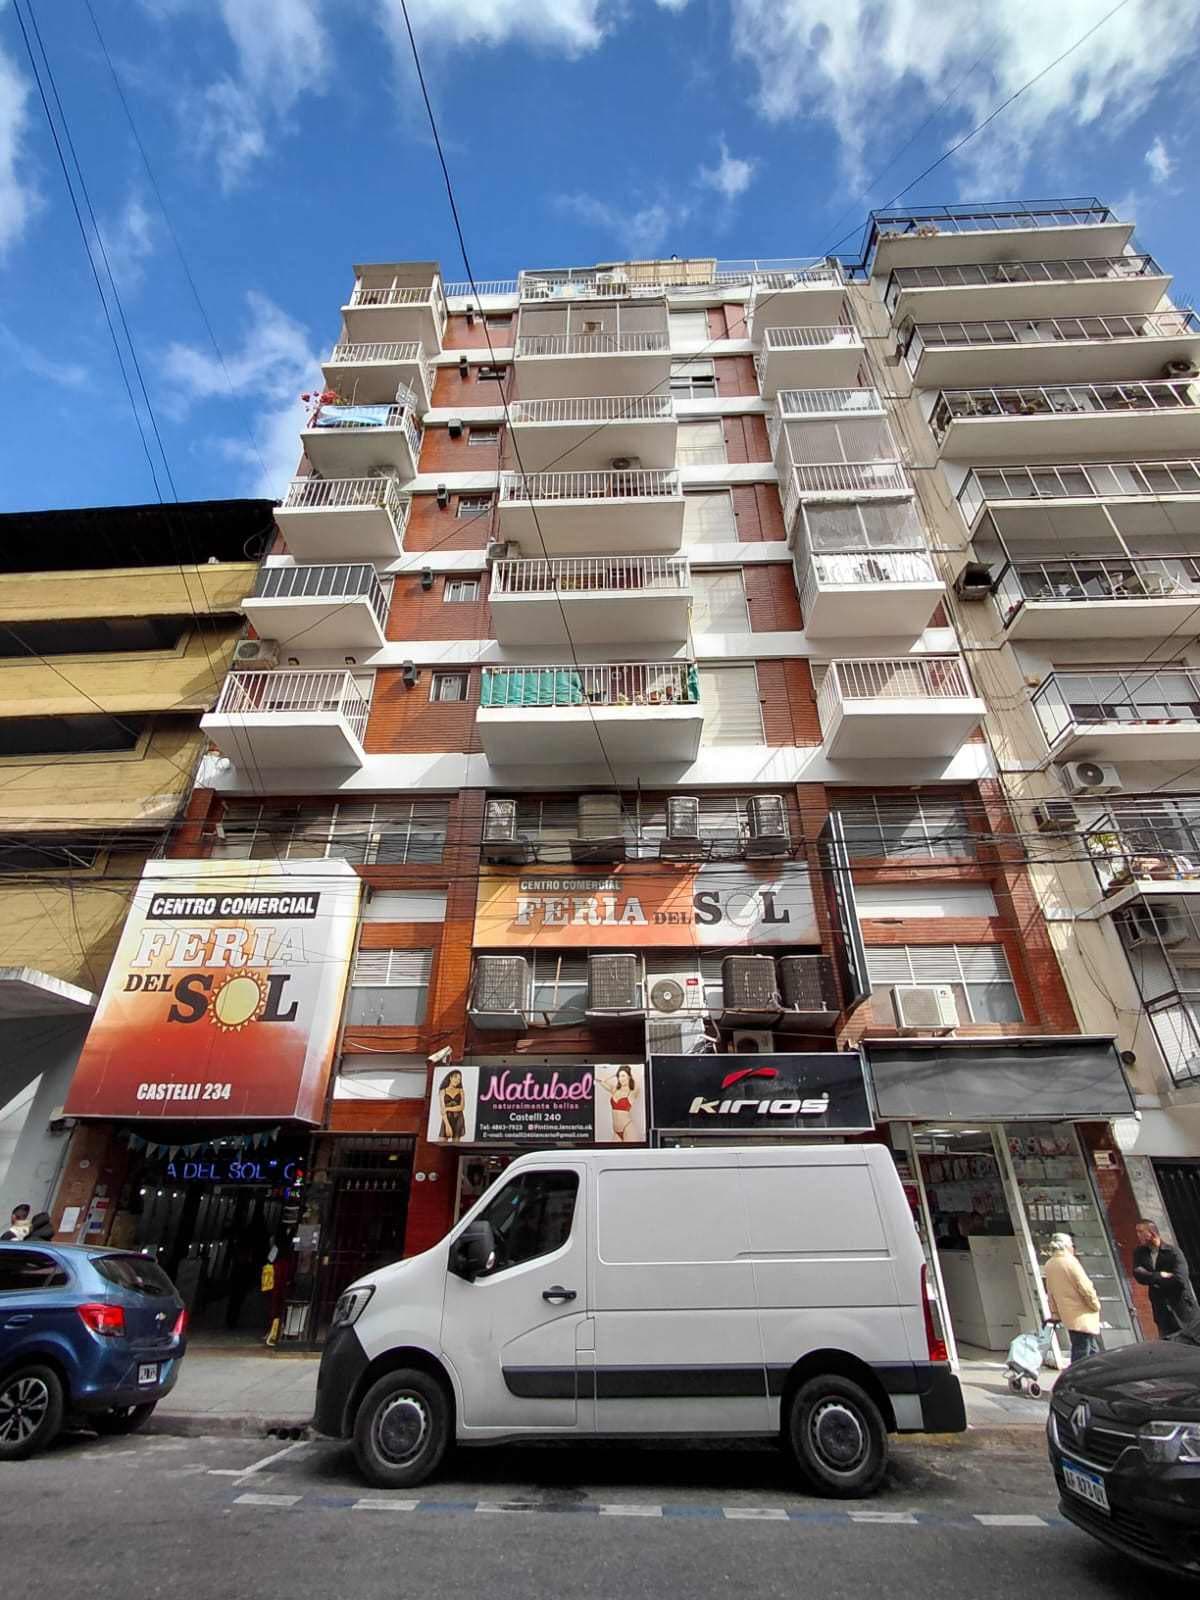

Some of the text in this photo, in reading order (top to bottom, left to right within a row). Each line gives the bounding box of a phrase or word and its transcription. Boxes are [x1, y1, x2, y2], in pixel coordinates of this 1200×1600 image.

[519, 880, 621, 892] CENTRO COMERCIAL
[152, 896, 316, 916] CENTRO COMERCIAL
[514, 891, 790, 927] FERIA DEL SOL
[130, 927, 308, 968] FERIA
[123, 970, 299, 1028] DEL SOL
[136, 1083, 232, 1100] CASTELLI 234
[480, 1070, 593, 1101] Natubel
[492, 1102, 579, 1110] naturalmente bellas
[688, 1092, 830, 1114] kirios
[509, 1112, 562, 1121] Castelli 240
[184, 1162, 220, 1179] DEL
